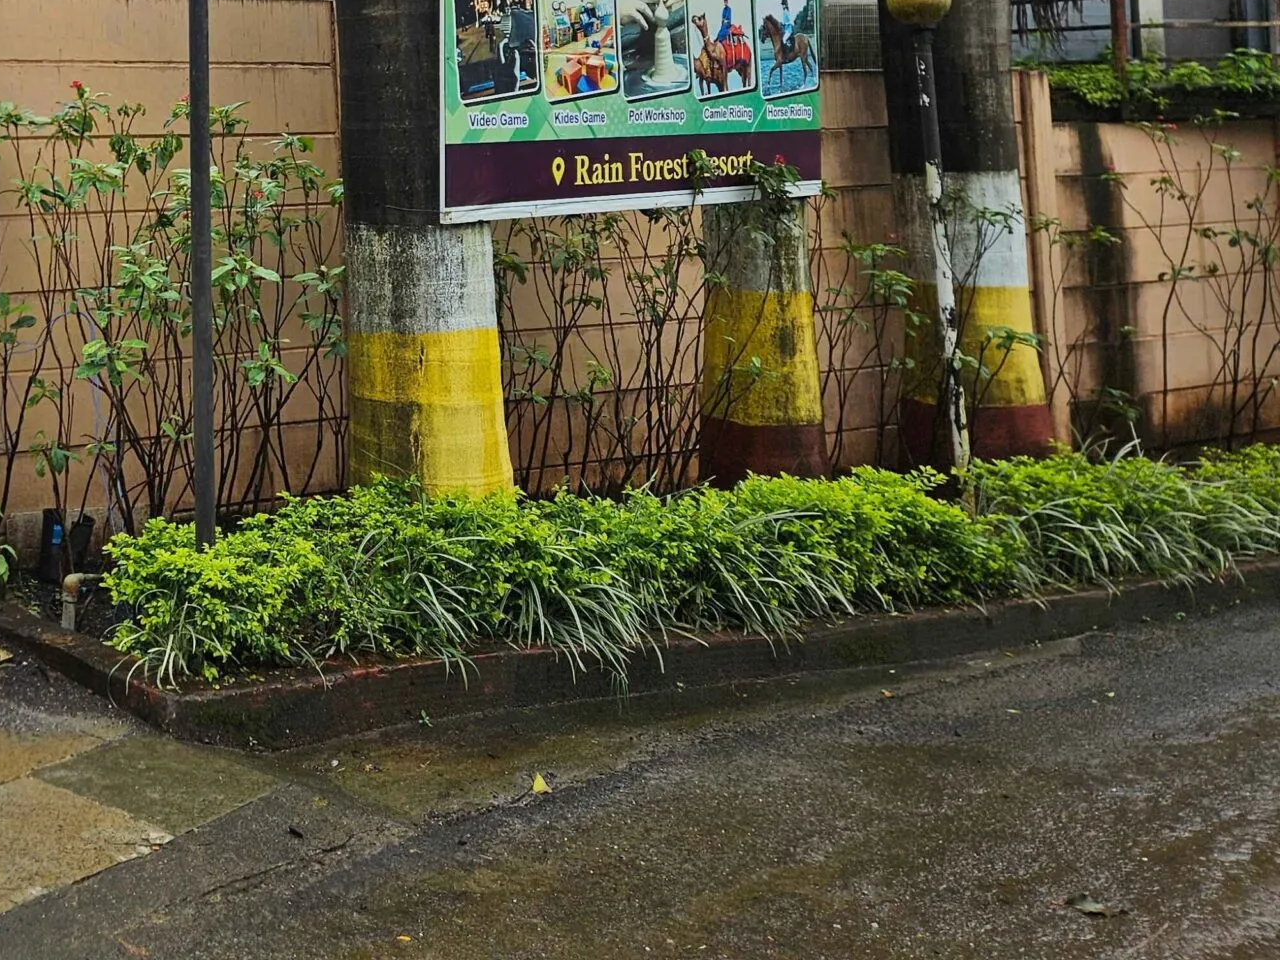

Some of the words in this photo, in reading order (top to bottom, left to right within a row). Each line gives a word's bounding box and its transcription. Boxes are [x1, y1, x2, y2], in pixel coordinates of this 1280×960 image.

[554, 112, 579, 125] Kides
[581, 111, 606, 125] Game
[628, 110, 644, 123] Pot
[644, 109, 685, 123] Workshop
[703, 107, 728, 120] Camle
[729, 107, 753, 122] Riding
[767, 105, 790, 119] Horse
[790, 105, 812, 120] Riding
[469, 114, 498, 127] Video
[500, 113, 528, 127] Game
[573, 152, 625, 186] Rain
[627, 151, 690, 183] Forest
